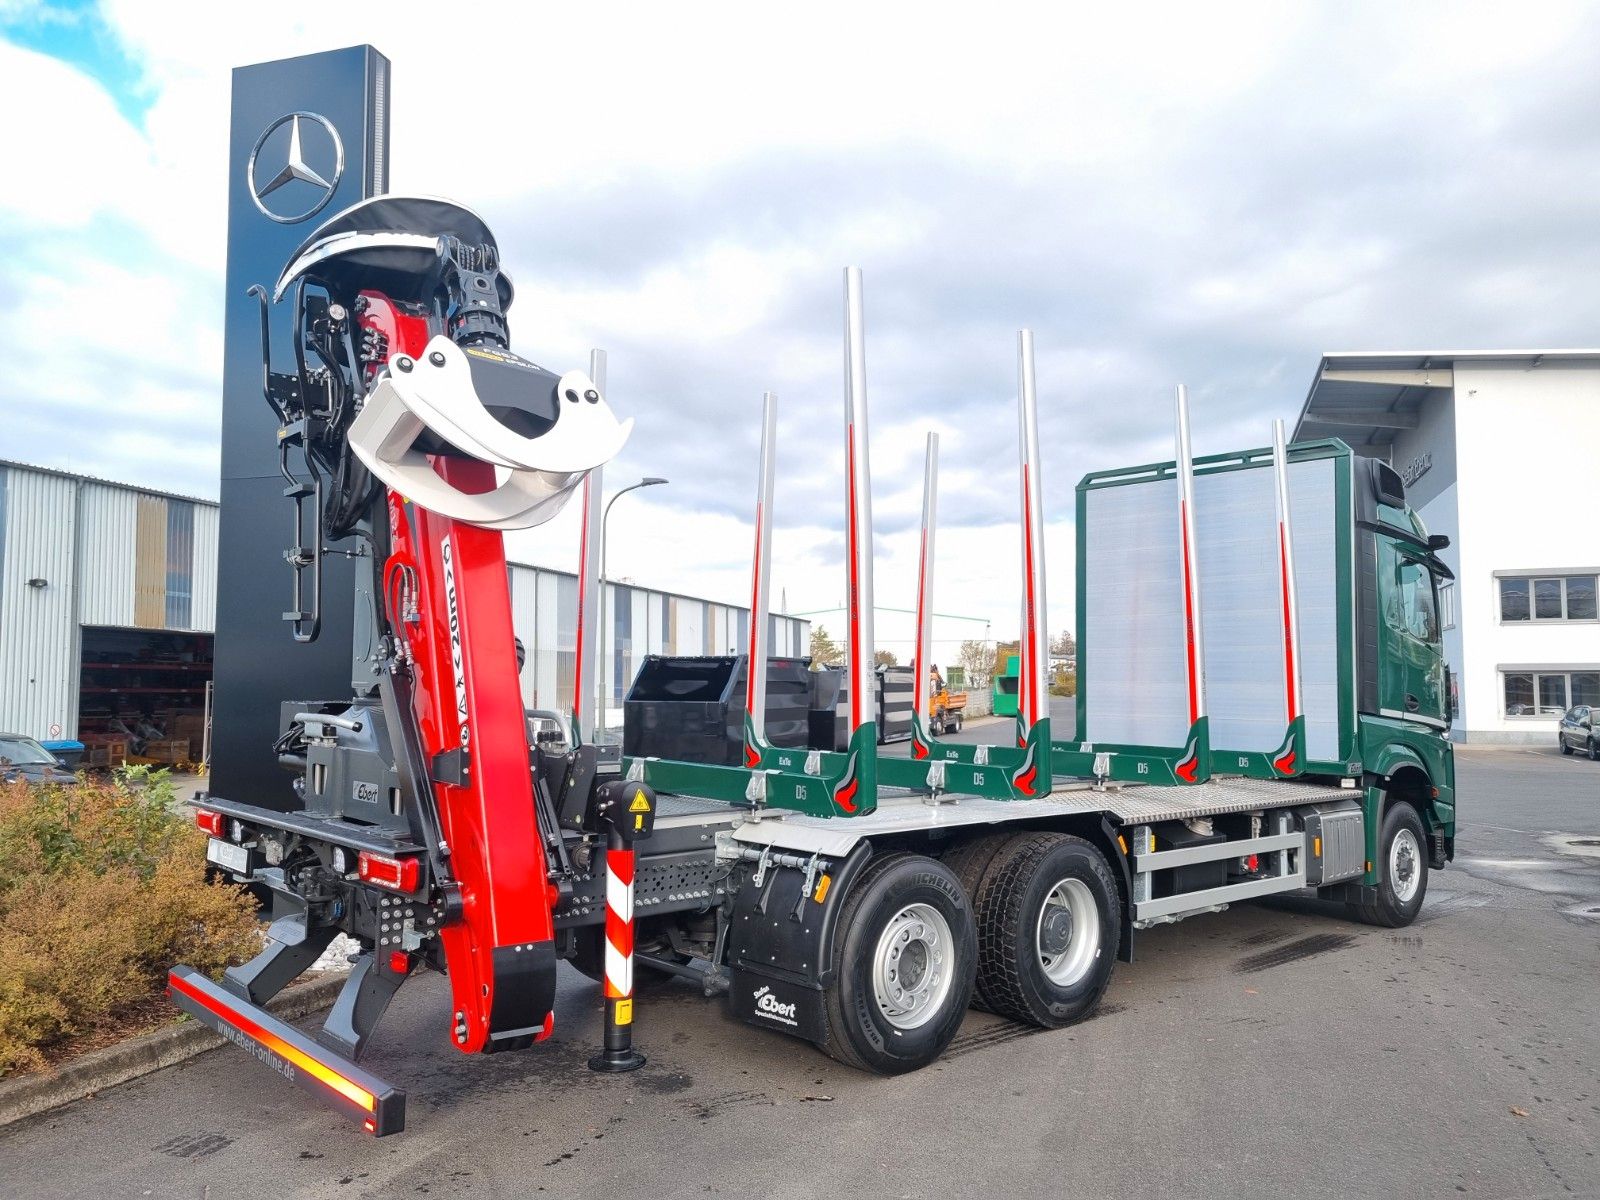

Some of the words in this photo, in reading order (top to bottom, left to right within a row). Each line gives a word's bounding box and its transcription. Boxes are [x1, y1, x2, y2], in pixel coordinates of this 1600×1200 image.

[1137, 762, 1149, 774] D5
[1238, 757, 1249, 768] D5
[973, 772, 985, 786] D5
[795, 784, 807, 800] D5
[757, 994, 796, 1018] Ebert
[217, 1019, 295, 1082] www.ebert-online.de
